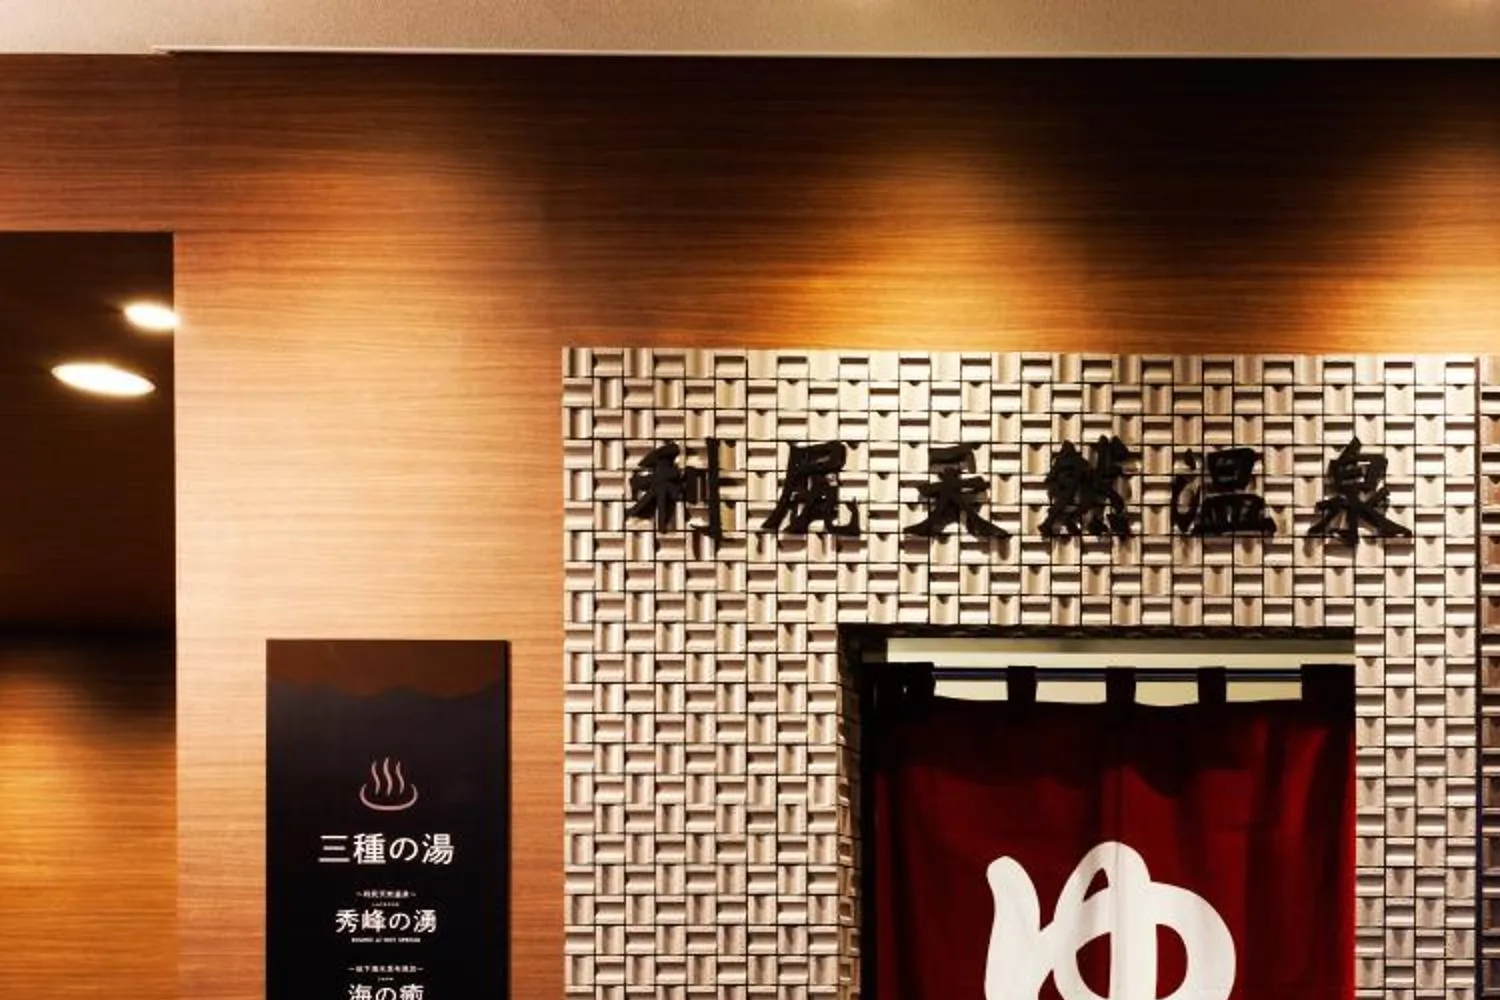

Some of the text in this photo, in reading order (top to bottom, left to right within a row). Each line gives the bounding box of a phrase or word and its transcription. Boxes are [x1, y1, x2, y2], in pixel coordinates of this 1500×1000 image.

[628, 436, 1413, 544] 利尻天然温泉
[319, 833, 455, 865] 三種の湯
[335, 908, 437, 933] 秀峰の湧
